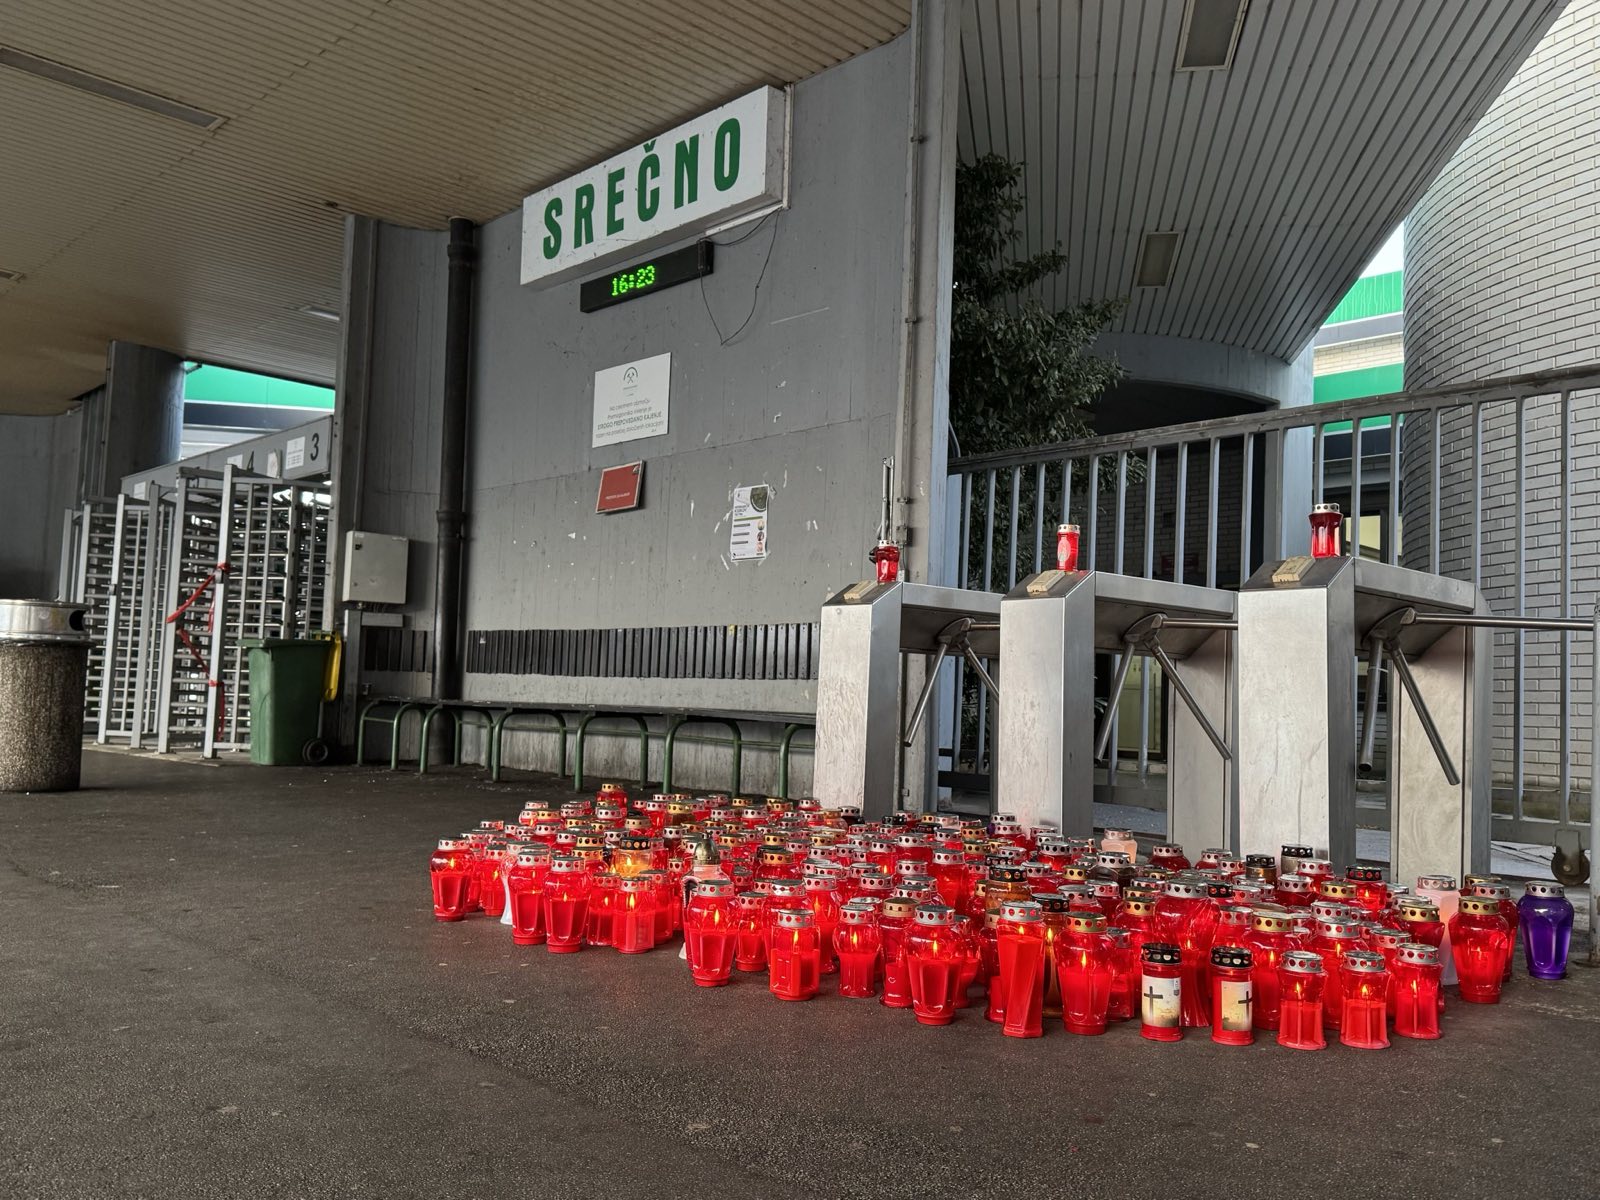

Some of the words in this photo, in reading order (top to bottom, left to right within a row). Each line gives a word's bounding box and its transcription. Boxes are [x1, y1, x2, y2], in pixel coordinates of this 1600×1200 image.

[543, 117, 741, 260] SREČNO
[611, 265, 656, 297] 16:23
[310, 433, 319, 461] 3
